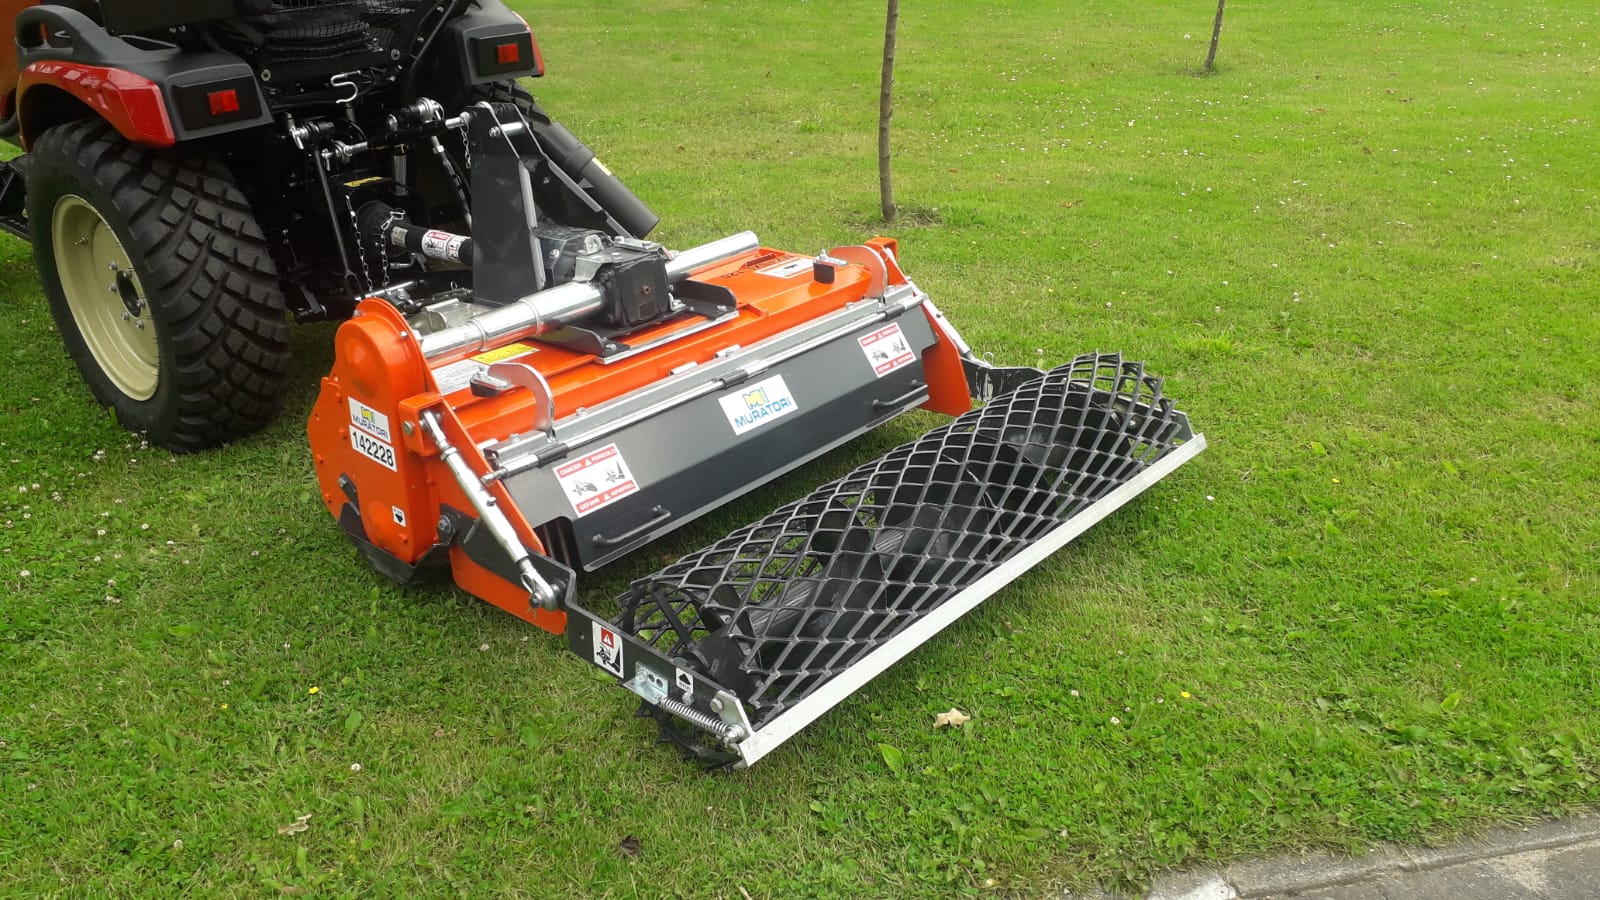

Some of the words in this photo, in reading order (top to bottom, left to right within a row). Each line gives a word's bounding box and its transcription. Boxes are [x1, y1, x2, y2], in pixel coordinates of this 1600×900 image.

[352, 414, 389, 439] MURATORI
[734, 397, 792, 428] MURATORI
[352, 432, 394, 467] 142228
[558, 461, 582, 475] DANGER
[590, 446, 617, 462] PERICOLO
[578, 496, 600, 510] GEFAHR
